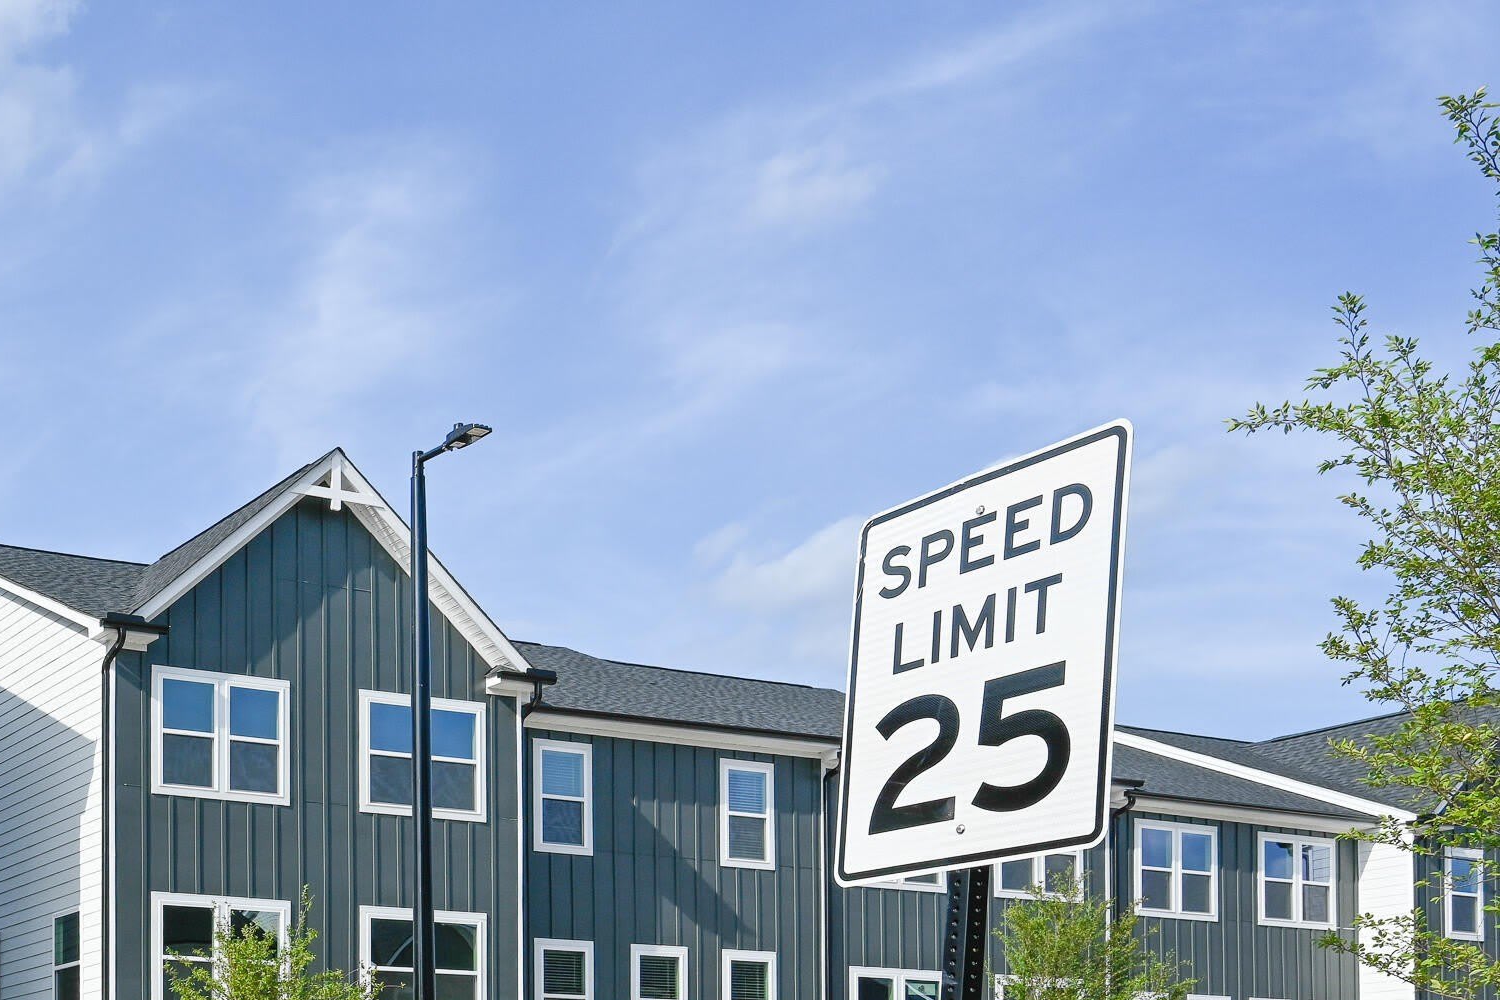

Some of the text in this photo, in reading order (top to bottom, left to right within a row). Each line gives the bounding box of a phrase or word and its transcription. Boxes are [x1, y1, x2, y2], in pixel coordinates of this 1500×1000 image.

[878, 482, 1094, 599] SPEED
[892, 572, 1063, 675] LIMIT
[868, 660, 1071, 836] 25
